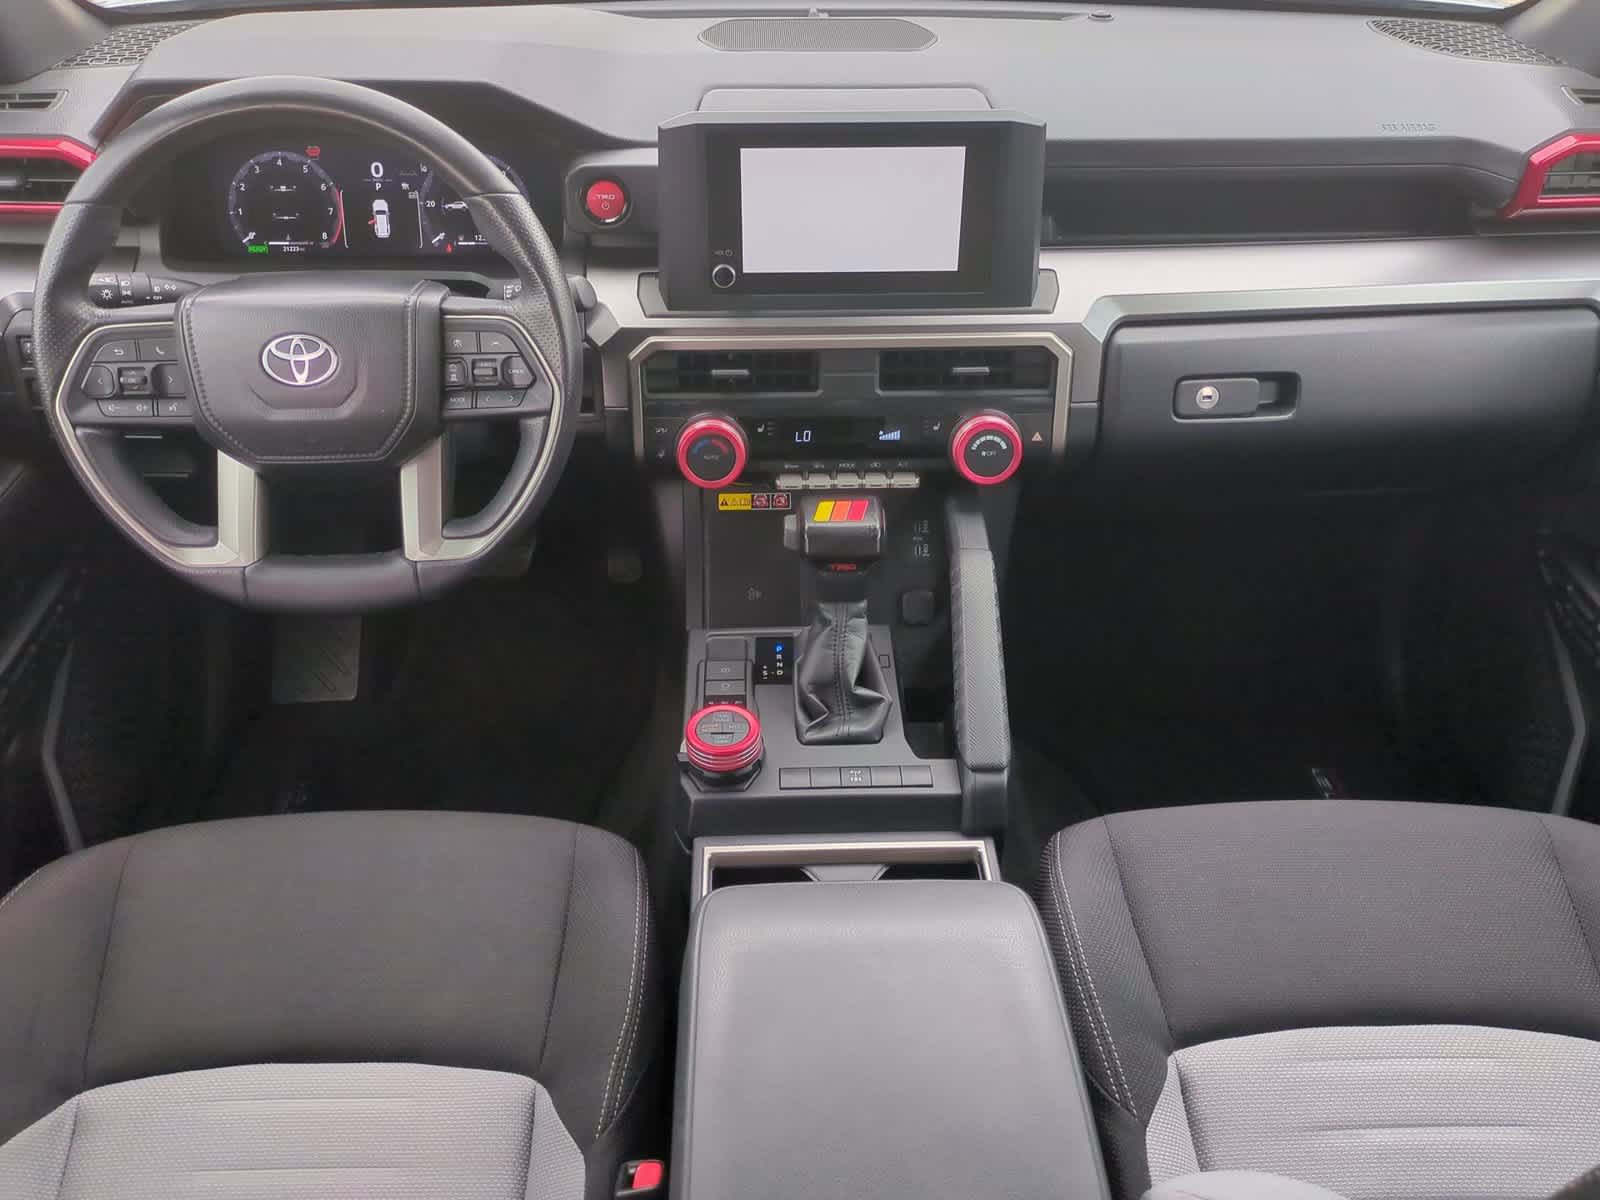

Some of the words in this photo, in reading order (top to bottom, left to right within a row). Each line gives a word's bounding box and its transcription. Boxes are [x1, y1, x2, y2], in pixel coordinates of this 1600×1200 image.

[370, 161, 384, 178] 0
[426, 200, 436, 208] 20
[794, 430, 812, 442] LO
